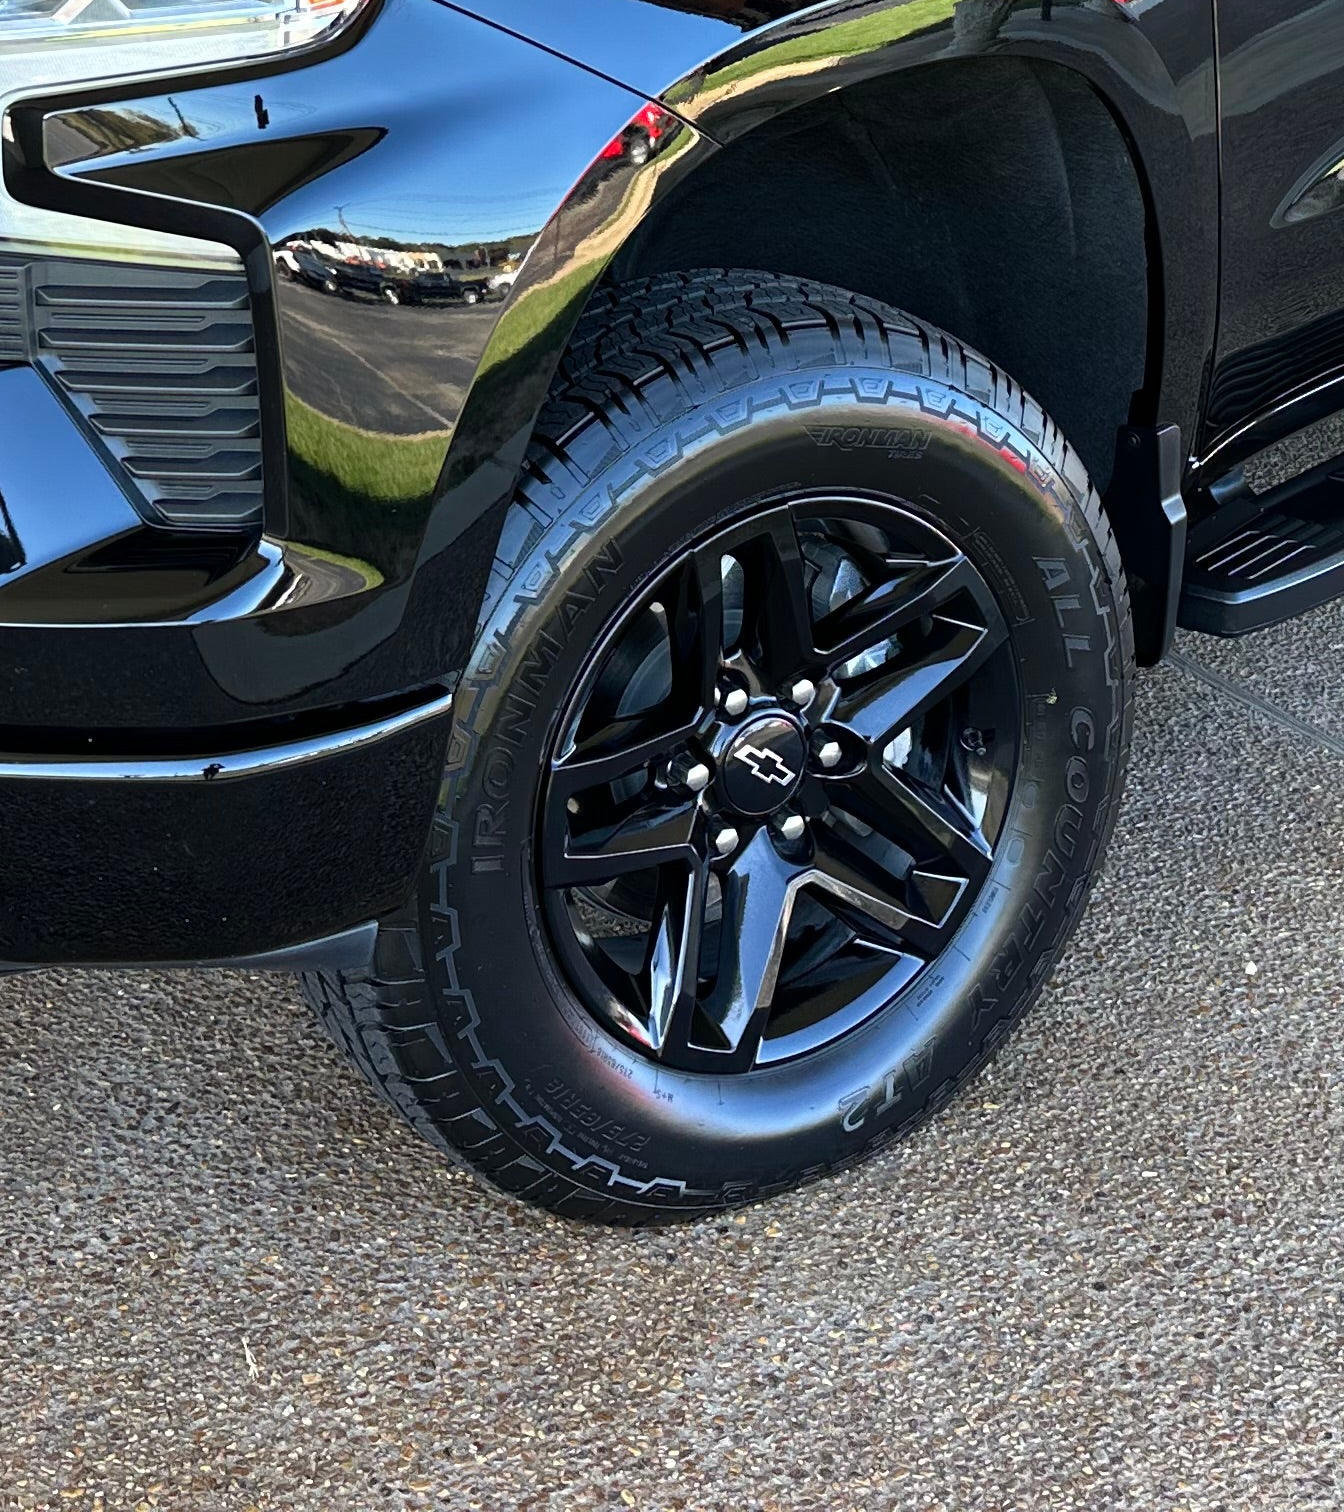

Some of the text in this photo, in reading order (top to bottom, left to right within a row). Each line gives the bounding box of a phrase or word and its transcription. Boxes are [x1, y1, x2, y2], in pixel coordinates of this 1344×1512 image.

[470, 535, 626, 874] IRONMAN
[1031, 556, 1095, 669] ALL
[967, 705, 1096, 1036] COUNTRY
[838, 1033, 937, 1133] AT2
